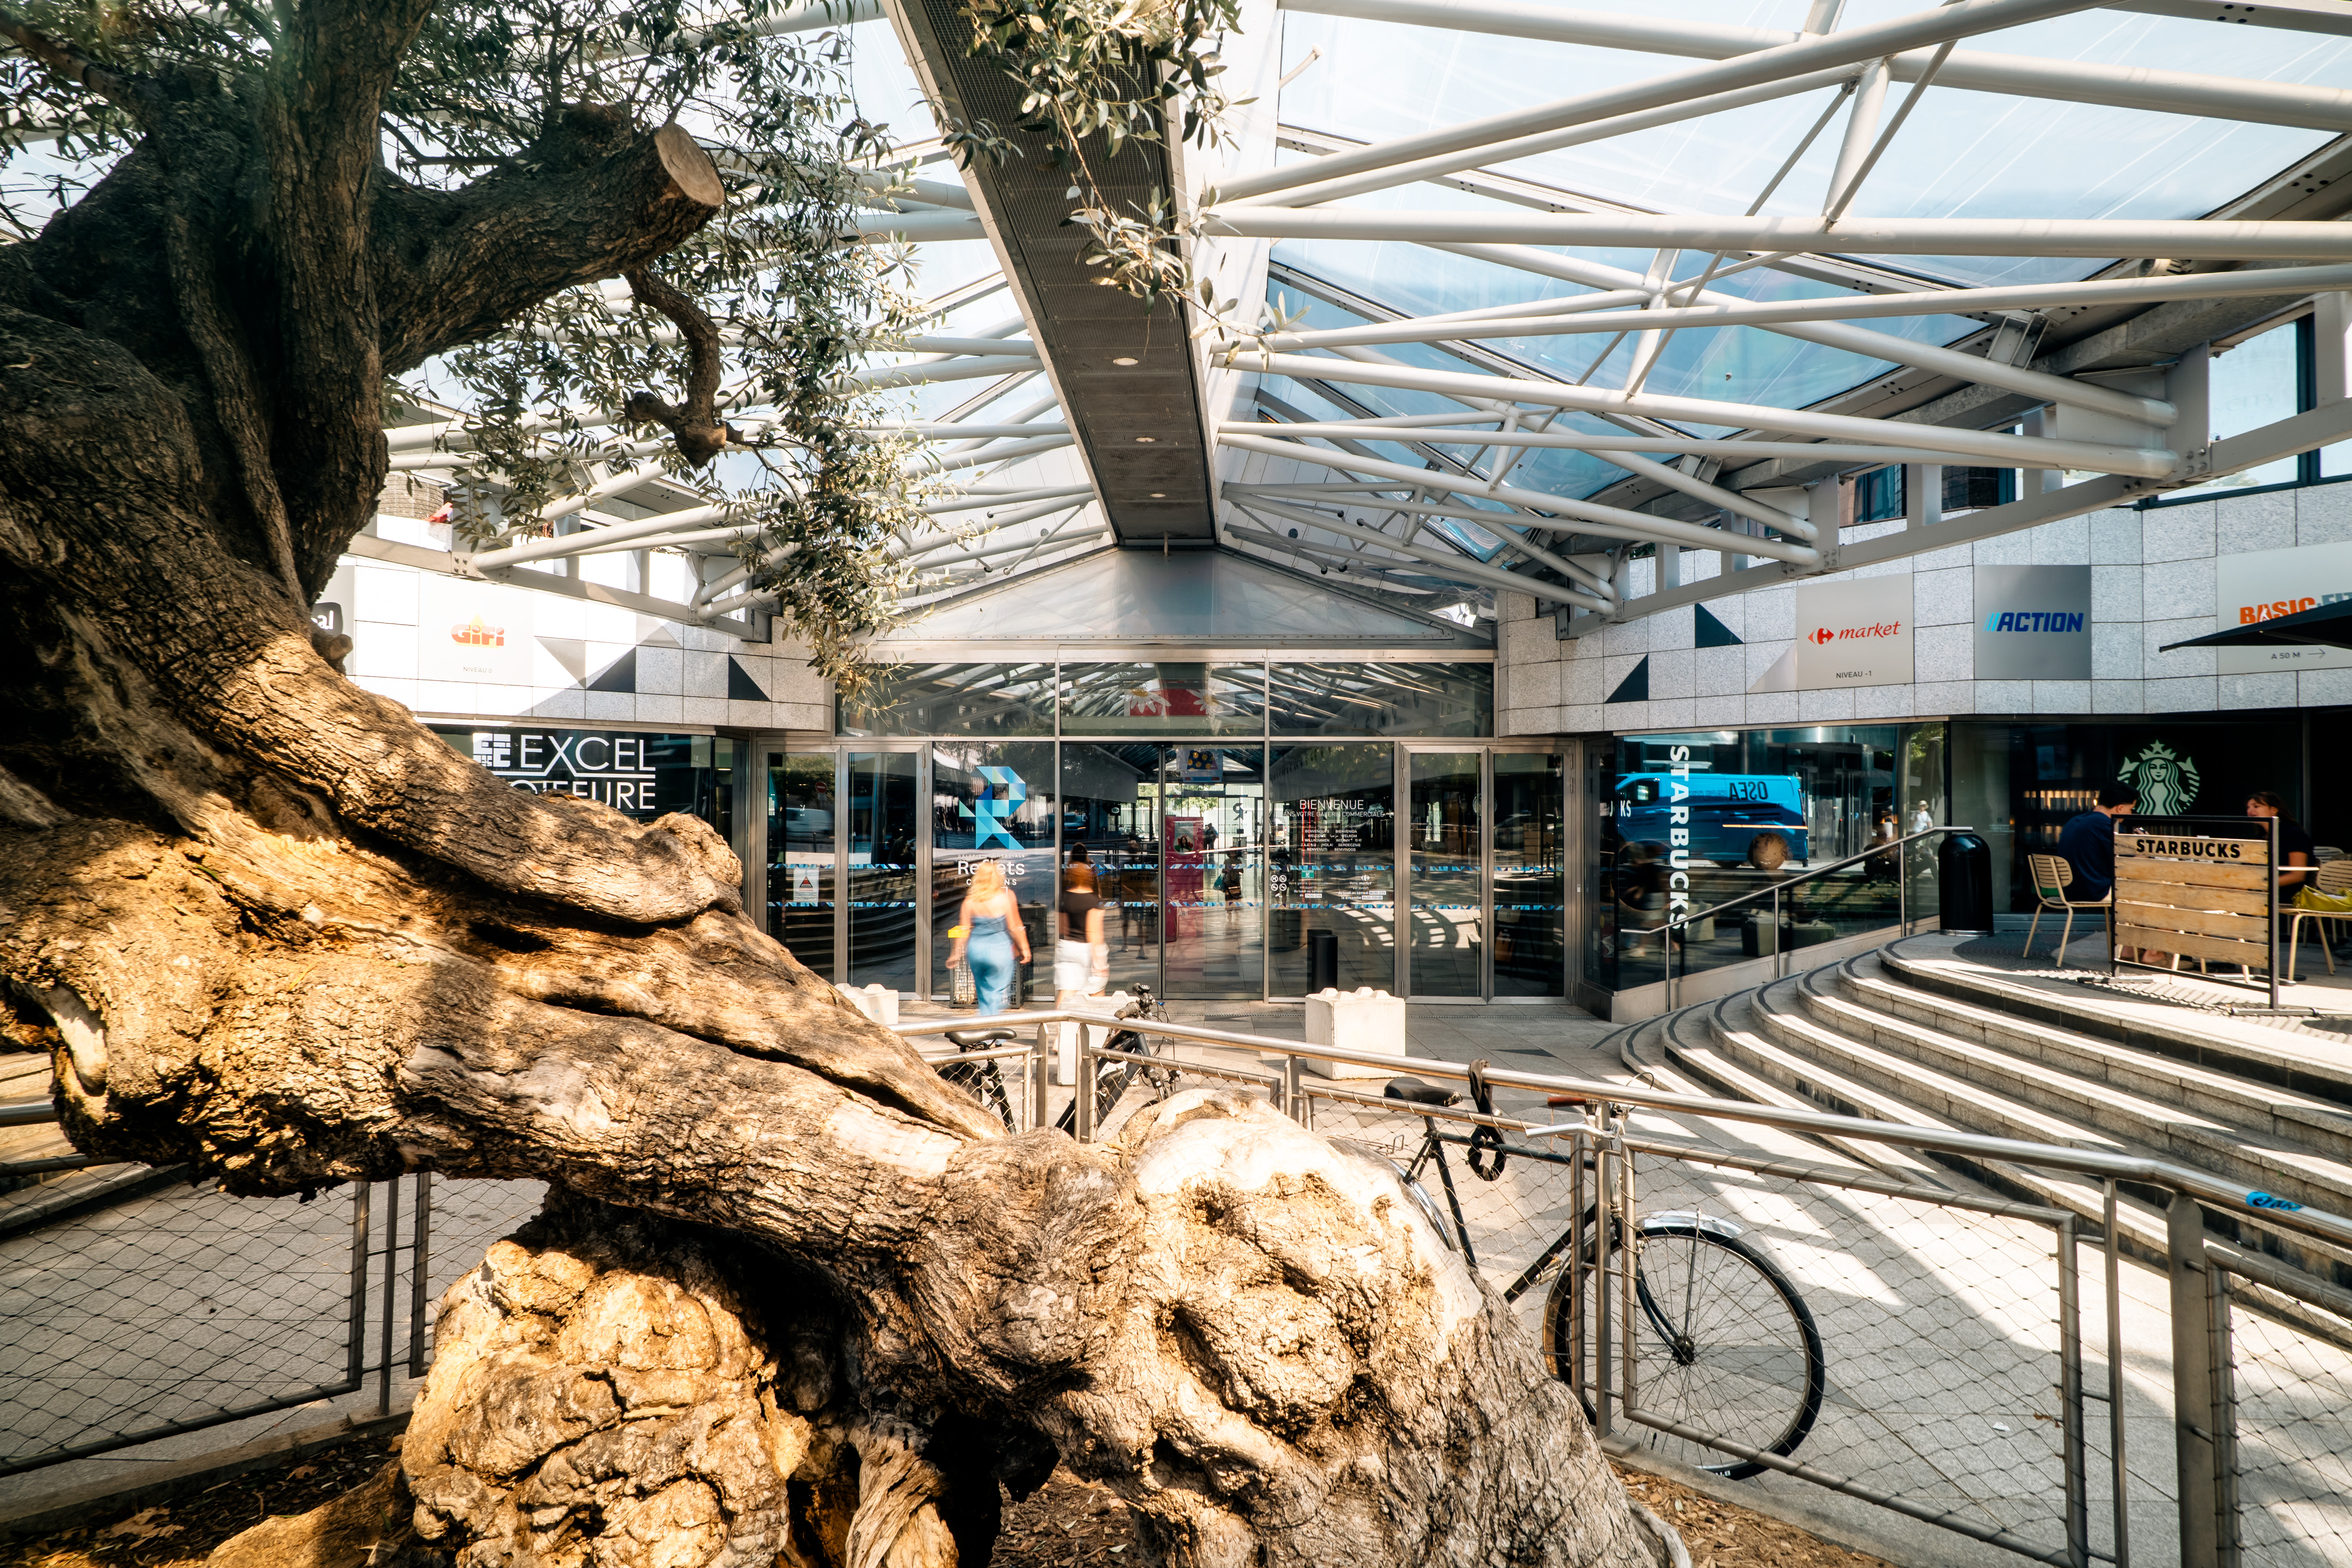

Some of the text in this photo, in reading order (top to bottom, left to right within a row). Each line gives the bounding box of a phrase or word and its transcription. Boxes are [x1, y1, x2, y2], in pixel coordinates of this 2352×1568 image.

[1839, 621, 1901, 640] market
[1996, 612, 2084, 633] ACTION
[521, 735, 656, 771] EXCEL
[1299, 800, 1364, 810] BIENVENUE
[1670, 745, 1690, 930] STARBUCKS
[2136, 839, 2241, 858] STARBUCKS
[958, 859, 1025, 875] Reets
